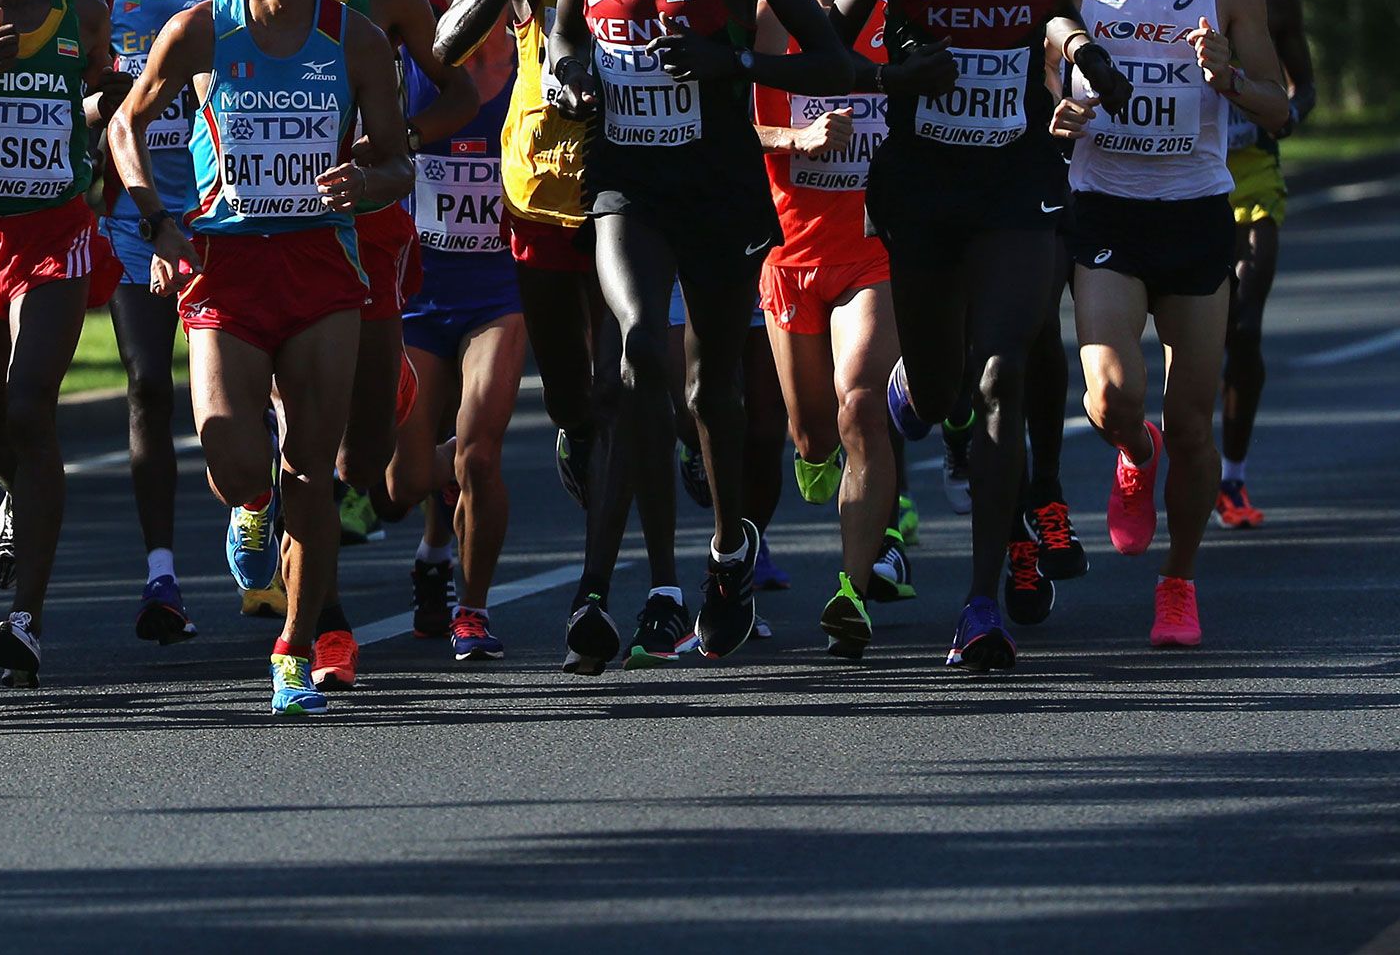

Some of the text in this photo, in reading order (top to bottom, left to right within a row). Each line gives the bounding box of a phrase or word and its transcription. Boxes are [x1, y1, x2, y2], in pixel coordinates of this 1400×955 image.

[927, 4, 1032, 28] KENYA
[953, 52, 1022, 75] TDK
[1119, 60, 1191, 84] TDK
[220, 90, 339, 111] MONGOLIA
[825, 97, 888, 119] TDK
[926, 86, 1018, 118] KORIR
[1110, 95, 1176, 125] NOH
[253, 116, 329, 139] TDK
[607, 123, 696, 143] BEIJING 2015
[921, 122, 985, 143] BEIJING
[1094, 132, 1194, 153] BEIJING 2015
[30, 180, 69, 196] 2015
[795, 171, 860, 188] BEIJING
[230, 197, 294, 215] BEIJING
[437, 193, 501, 225] PAK
[420, 230, 479, 250] BEIJING
